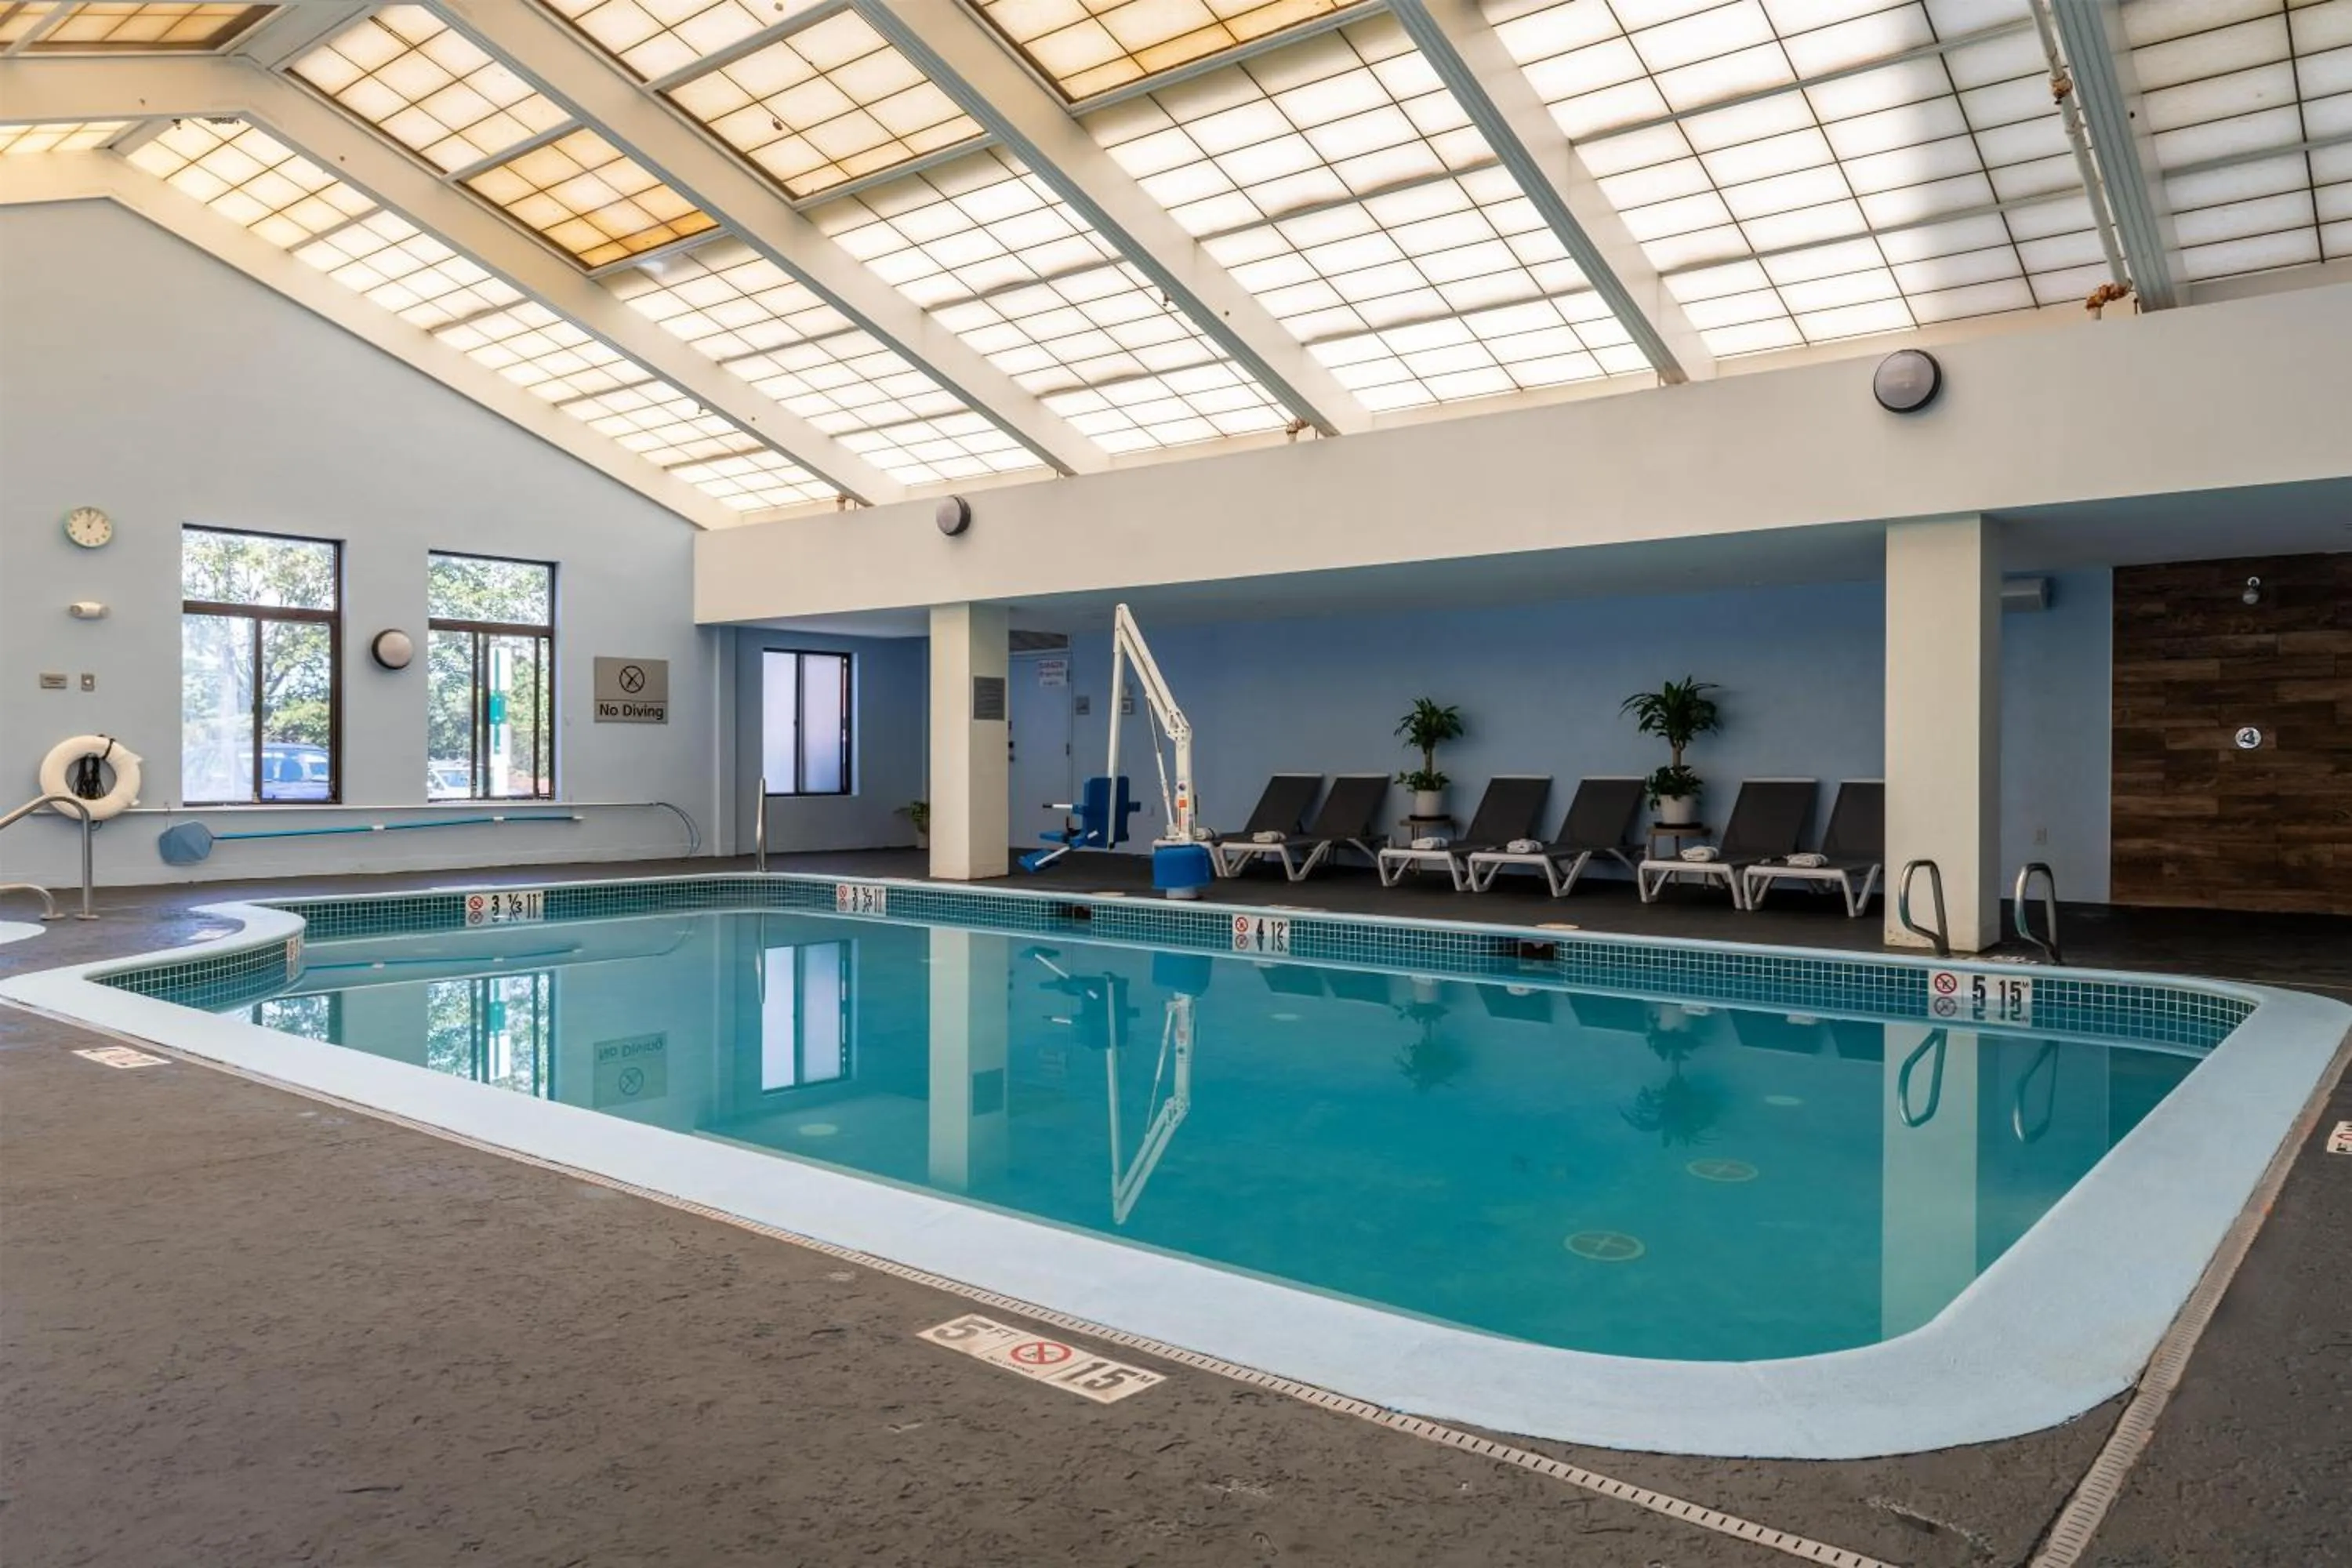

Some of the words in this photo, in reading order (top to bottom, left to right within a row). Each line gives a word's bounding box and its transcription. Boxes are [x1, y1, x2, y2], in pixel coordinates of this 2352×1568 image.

[600, 703, 619, 716] No
[623, 703, 664, 720] Diving
[1973, 975, 1986, 1001] 5
[933, 1316, 993, 1340] 5
[986, 1327, 1018, 1339] FT
